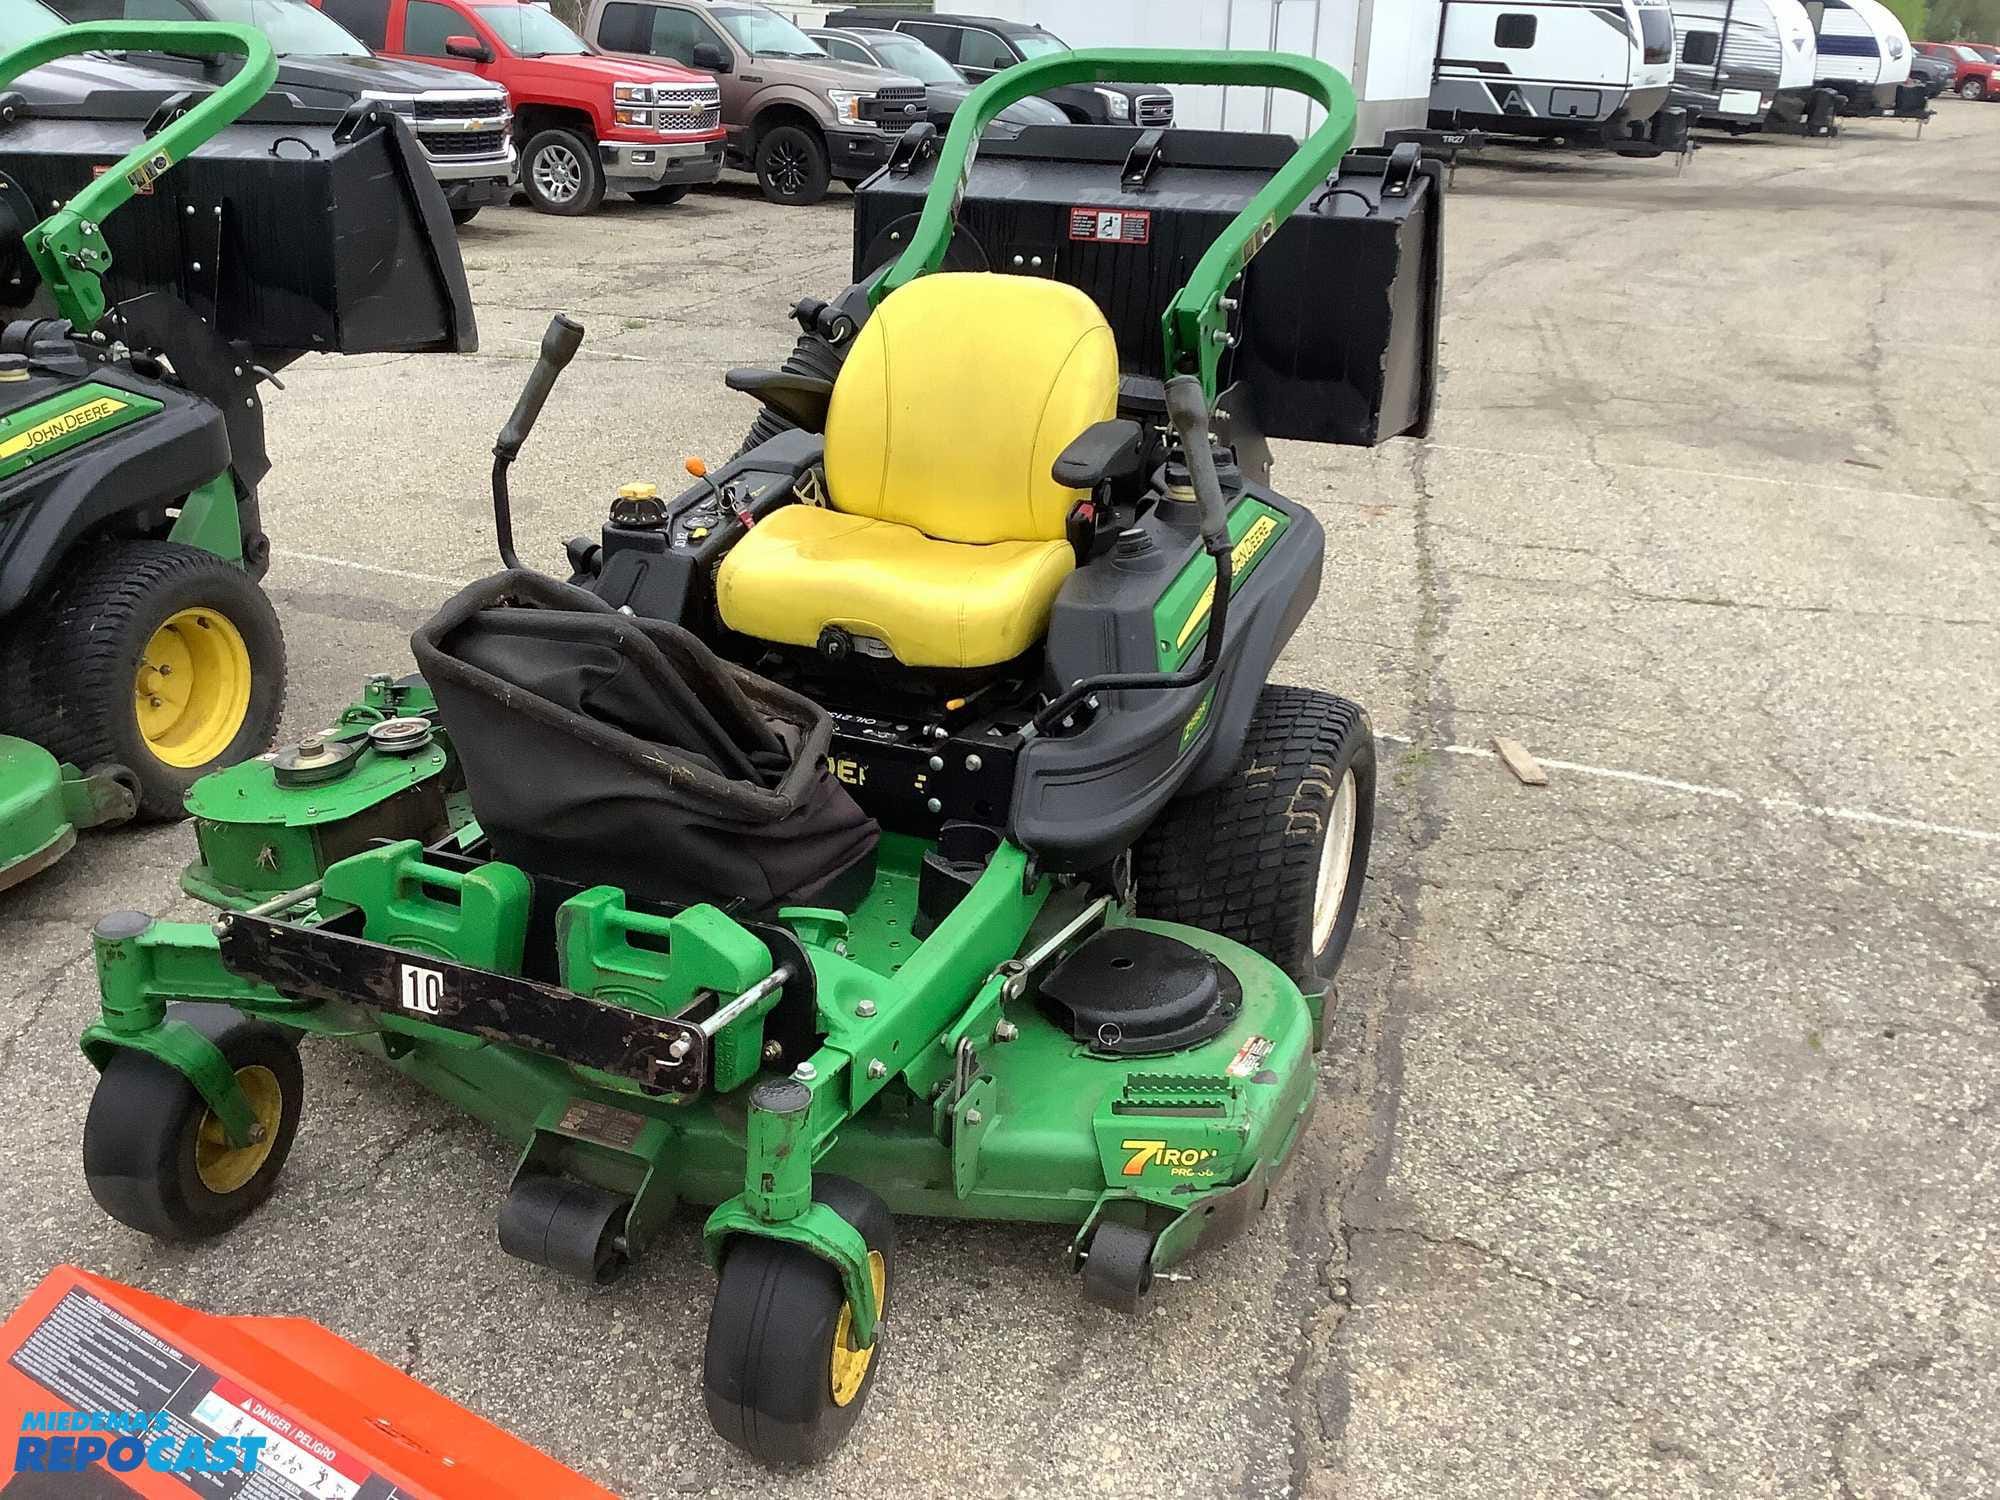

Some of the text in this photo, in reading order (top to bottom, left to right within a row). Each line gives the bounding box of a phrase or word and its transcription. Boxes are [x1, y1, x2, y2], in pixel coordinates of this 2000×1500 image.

[26, 403, 111, 448] JOHN DEERE
[408, 970, 440, 1011] 10
[252, 1403, 291, 1434] DANGER
[294, 1431, 336, 1461] PELIGRO
